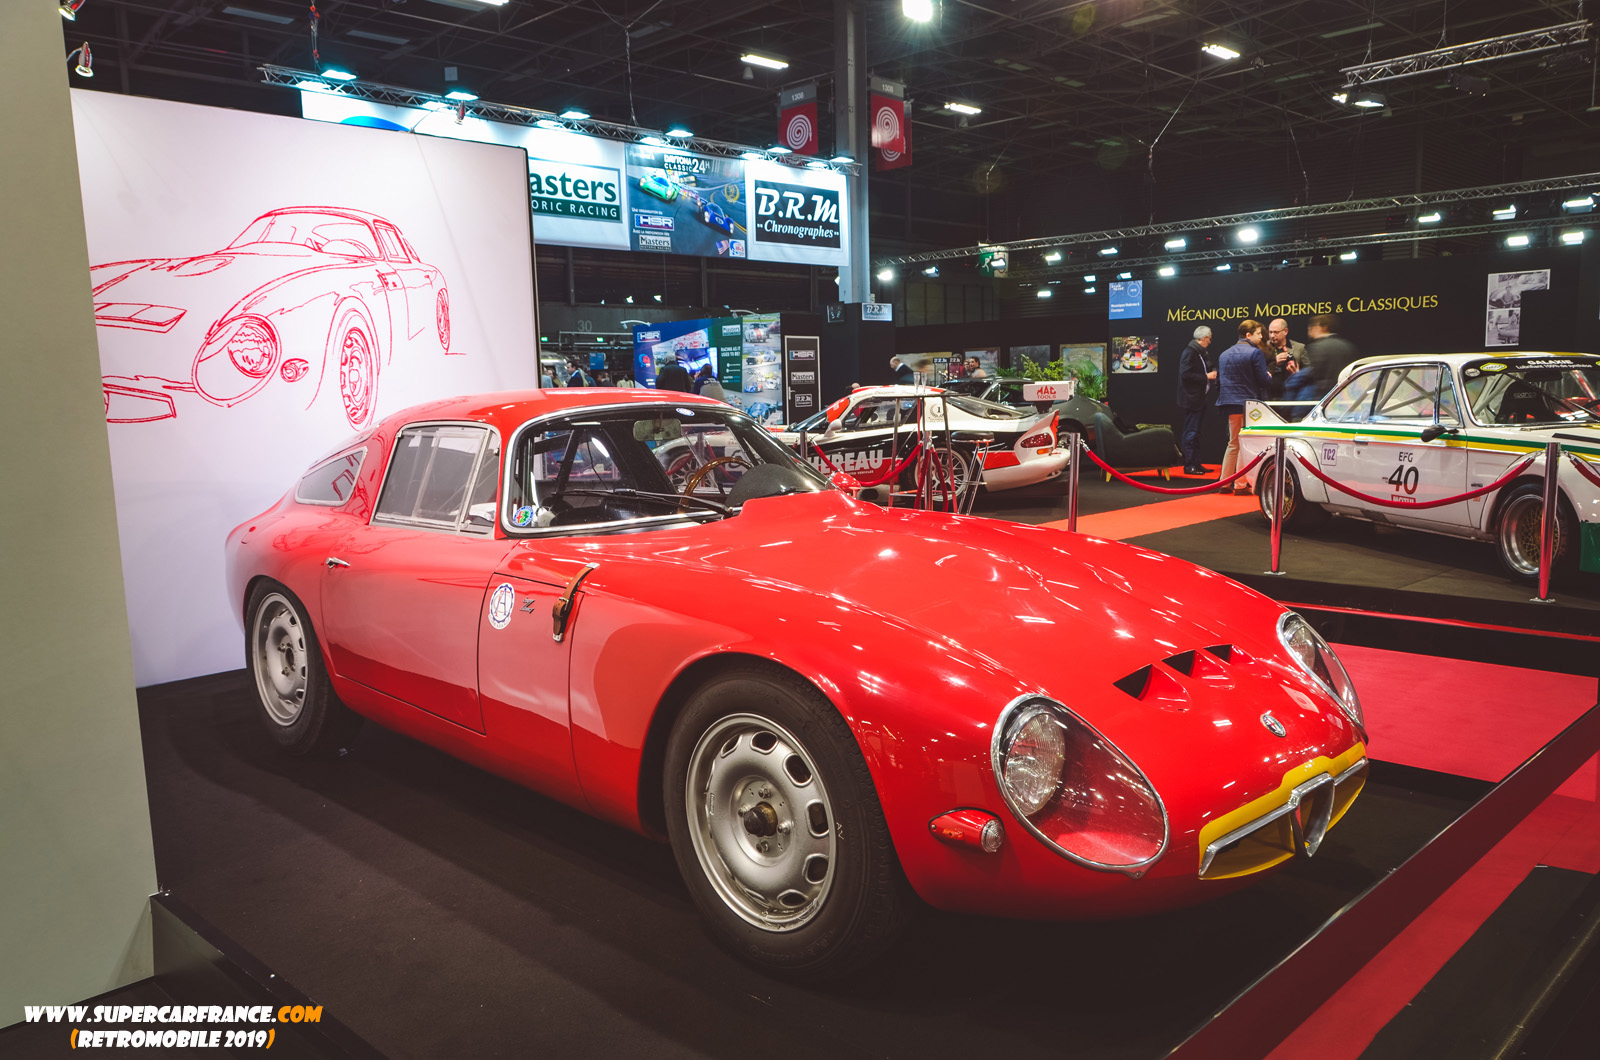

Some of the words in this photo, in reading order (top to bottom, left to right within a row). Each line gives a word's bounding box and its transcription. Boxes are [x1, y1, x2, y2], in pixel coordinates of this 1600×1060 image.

[663, 153, 692, 166] DAYTONA
[664, 163, 693, 172] CLASSIC
[529, 171, 617, 203] asters
[531, 199, 563, 212] ORIC
[569, 203, 618, 218] RACING
[640, 215, 673, 227] HSR
[764, 219, 834, 239] Chronographes
[640, 236, 670, 246] Masters
[1167, 305, 1250, 322] MÉCANIQUES
[1254, 301, 1332, 318] MODERNES
[1335, 303, 1344, 313] &
[1347, 295, 1439, 313] CLASSIQUES
[577, 320, 592, 332] 30
[791, 372, 814, 380] Masters
[1323, 448, 1336, 461] TC2
[1398, 451, 1414, 463] EFG
[807, 449, 884, 474] HEREAU
[1388, 464, 1420, 495] 40
